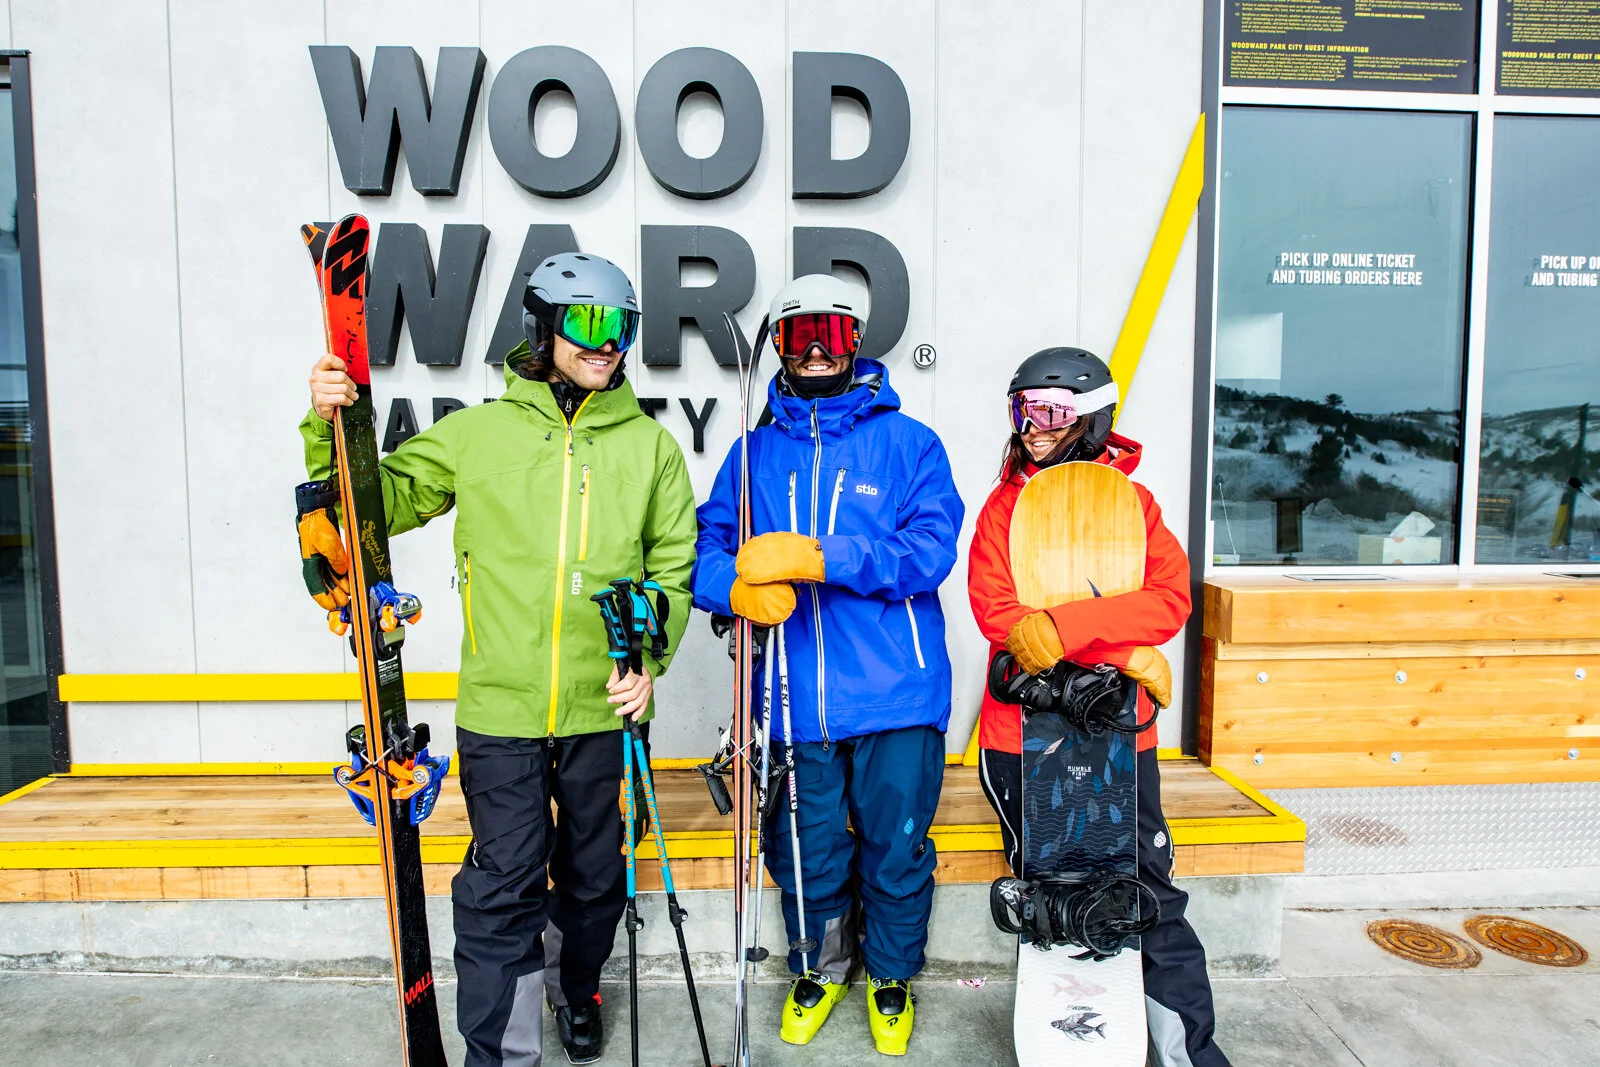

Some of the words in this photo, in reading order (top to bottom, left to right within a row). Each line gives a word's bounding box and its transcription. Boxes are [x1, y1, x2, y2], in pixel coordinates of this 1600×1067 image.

[1288, 43, 1303, 51] CITY
[1327, 45, 1369, 53] INFORMATION
[308, 44, 911, 200] WOOD
[1281, 252, 1309, 266] PICK
[1313, 253, 1328, 267] UP
[1332, 253, 1373, 267] ONLINE
[1376, 254, 1415, 268] TICKET
[1540, 255, 1568, 269] PICK
[1570, 256, 1587, 269] UP
[1272, 270, 1296, 283] AND
[1299, 270, 1341, 284] TUBING
[1345, 271, 1390, 285] ORDERS
[1393, 272, 1423, 285] HERE
[1532, 272, 1555, 286] AND
[1557, 272, 1598, 287] TUBING
[855, 483, 878, 496] stio
[571, 571, 583, 595] stio
[780, 675, 789, 708] LEKI
[763, 687, 771, 721] LEKI
